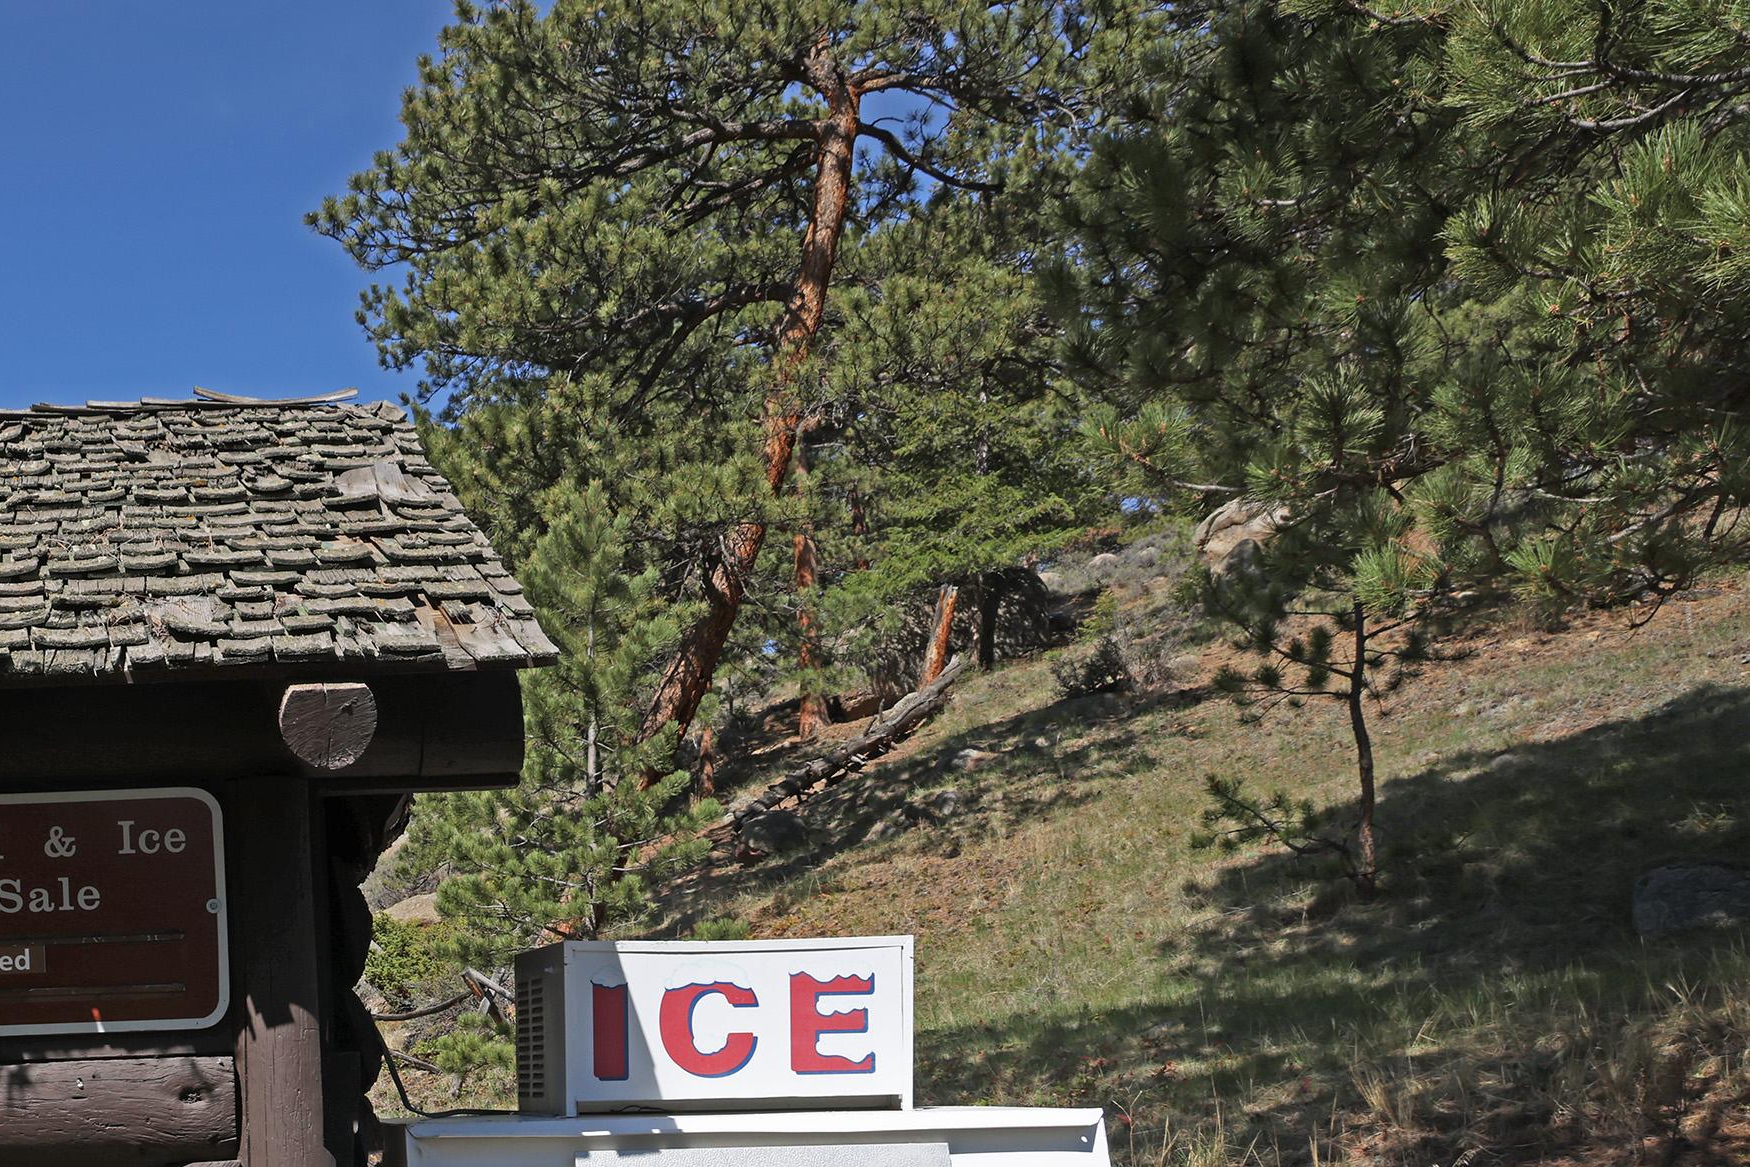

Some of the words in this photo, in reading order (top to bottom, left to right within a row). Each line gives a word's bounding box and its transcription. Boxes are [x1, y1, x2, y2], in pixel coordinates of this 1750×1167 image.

[43, 825, 77, 859] &
[117, 820, 187, 855] Ice
[590, 966, 877, 1081] ICE
